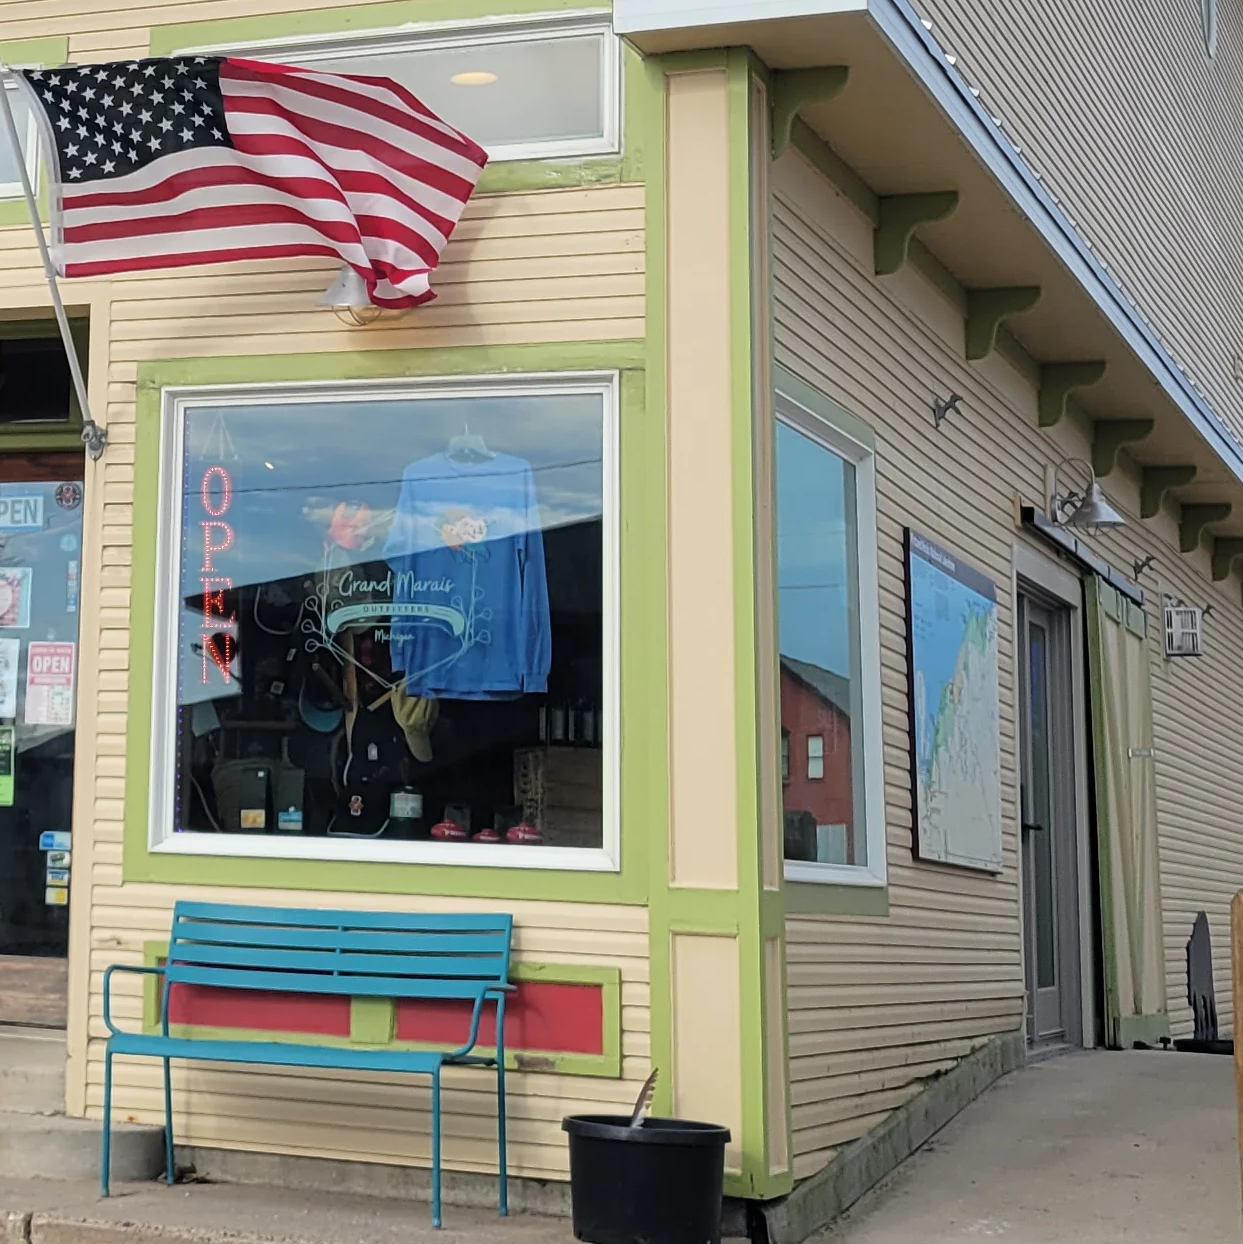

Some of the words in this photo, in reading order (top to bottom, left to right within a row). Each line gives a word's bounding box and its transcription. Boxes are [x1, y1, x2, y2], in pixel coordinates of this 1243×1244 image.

[200, 464, 235, 684] OPEN
[338, 570, 391, 597] Grand
[396, 570, 455, 599] Marais
[363, 605, 430, 613] OUTFITTERS
[32, 656, 71, 674] OPEN
